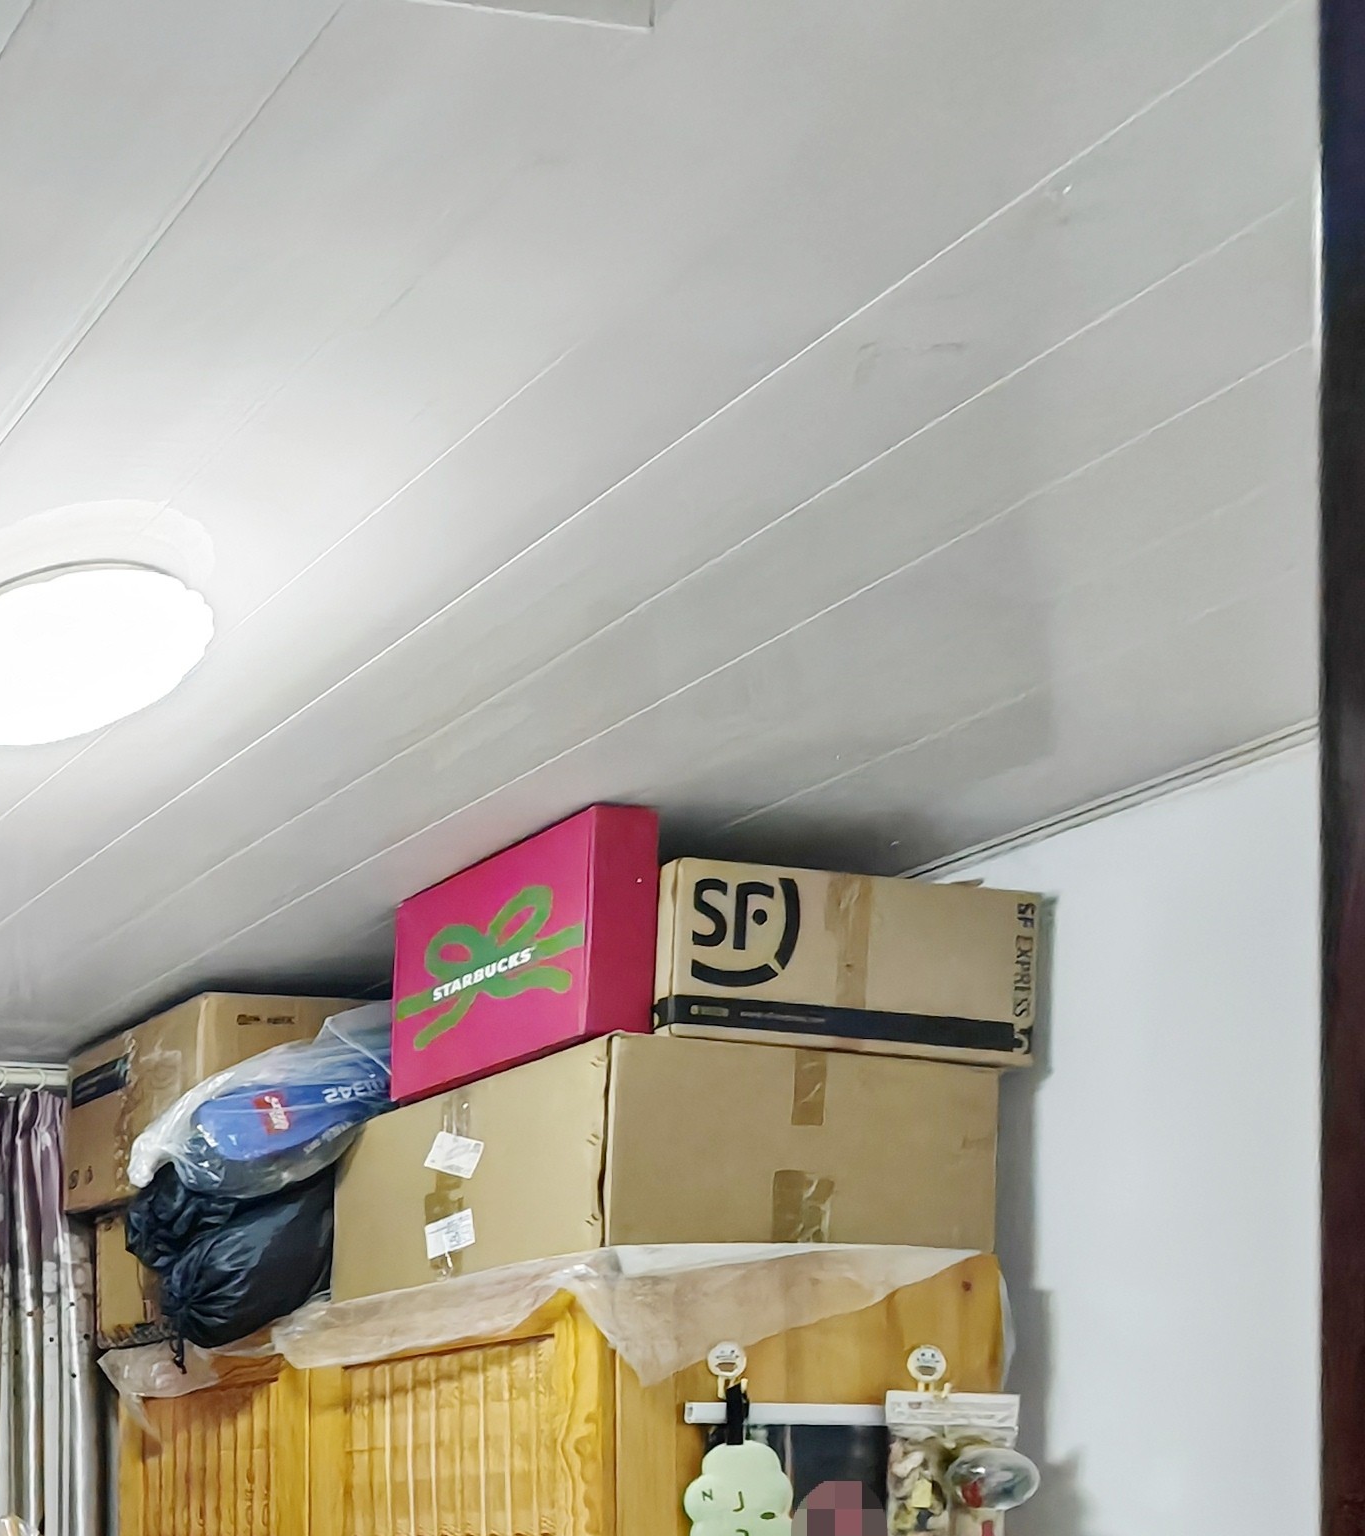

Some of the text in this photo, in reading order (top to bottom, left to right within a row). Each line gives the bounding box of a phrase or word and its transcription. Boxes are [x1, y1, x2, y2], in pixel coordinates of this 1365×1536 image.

[691, 877, 776, 951] SF
[1016, 901, 1037, 929] SF
[432, 947, 533, 1002] STARBUCKS
